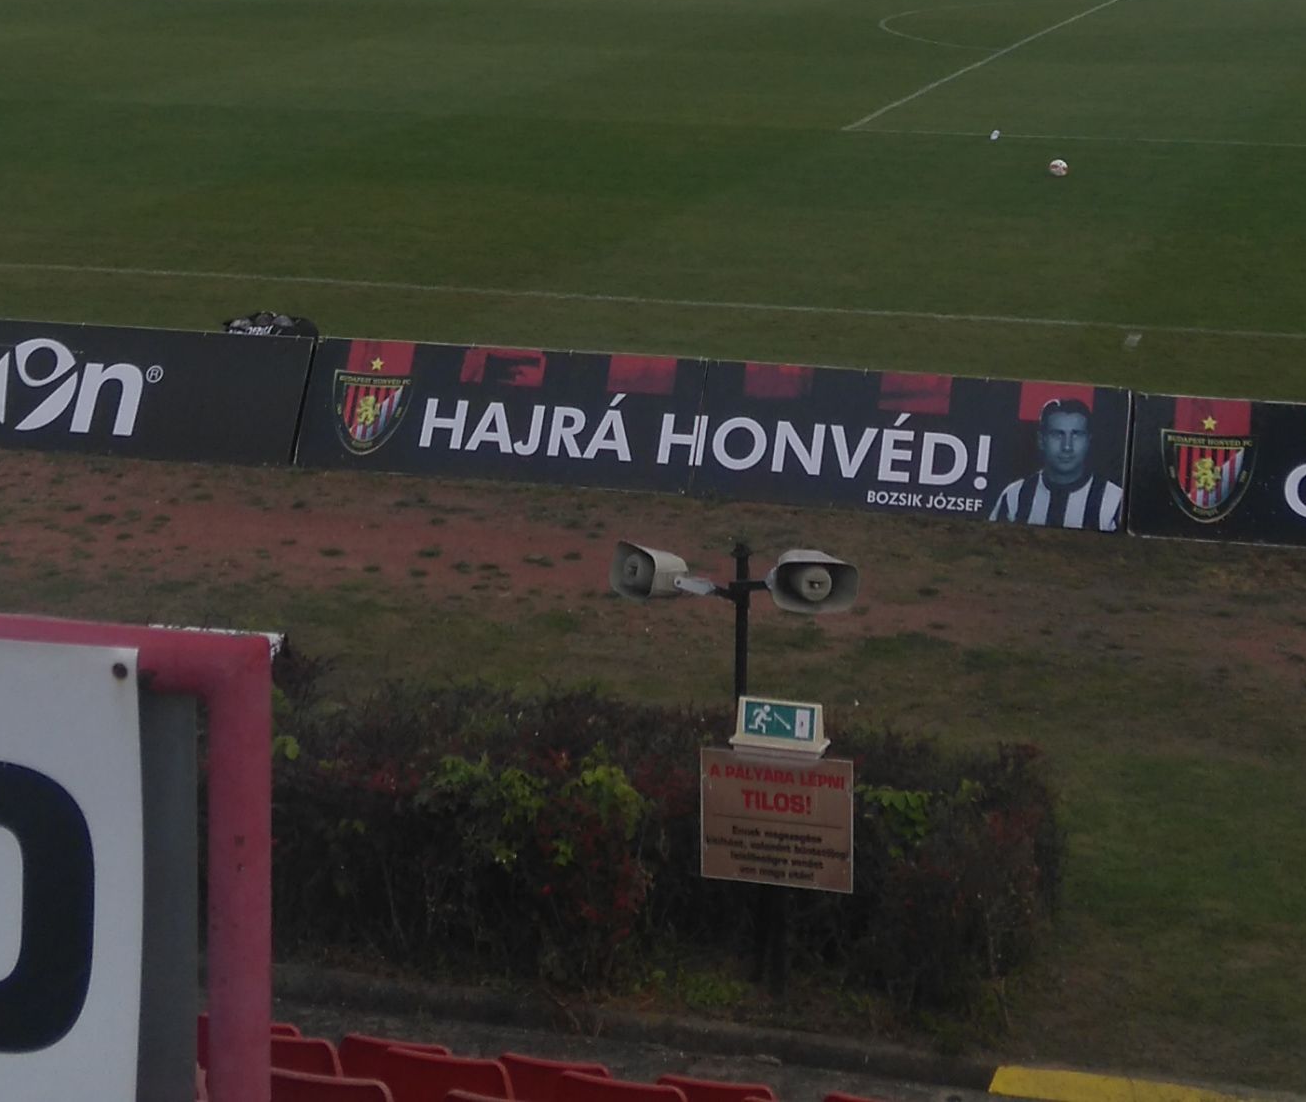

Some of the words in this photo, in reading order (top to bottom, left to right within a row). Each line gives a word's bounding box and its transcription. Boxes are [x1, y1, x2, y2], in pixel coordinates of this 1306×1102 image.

[419, 393, 633, 463] HAJRÁ
[657, 411, 992, 490] HONVÉD!
[866, 489, 923, 507] BOZSIK
[925, 492, 983, 512] JÓZSEF
[709, 763, 721, 778] A
[741, 788, 812, 815] TILOS!
